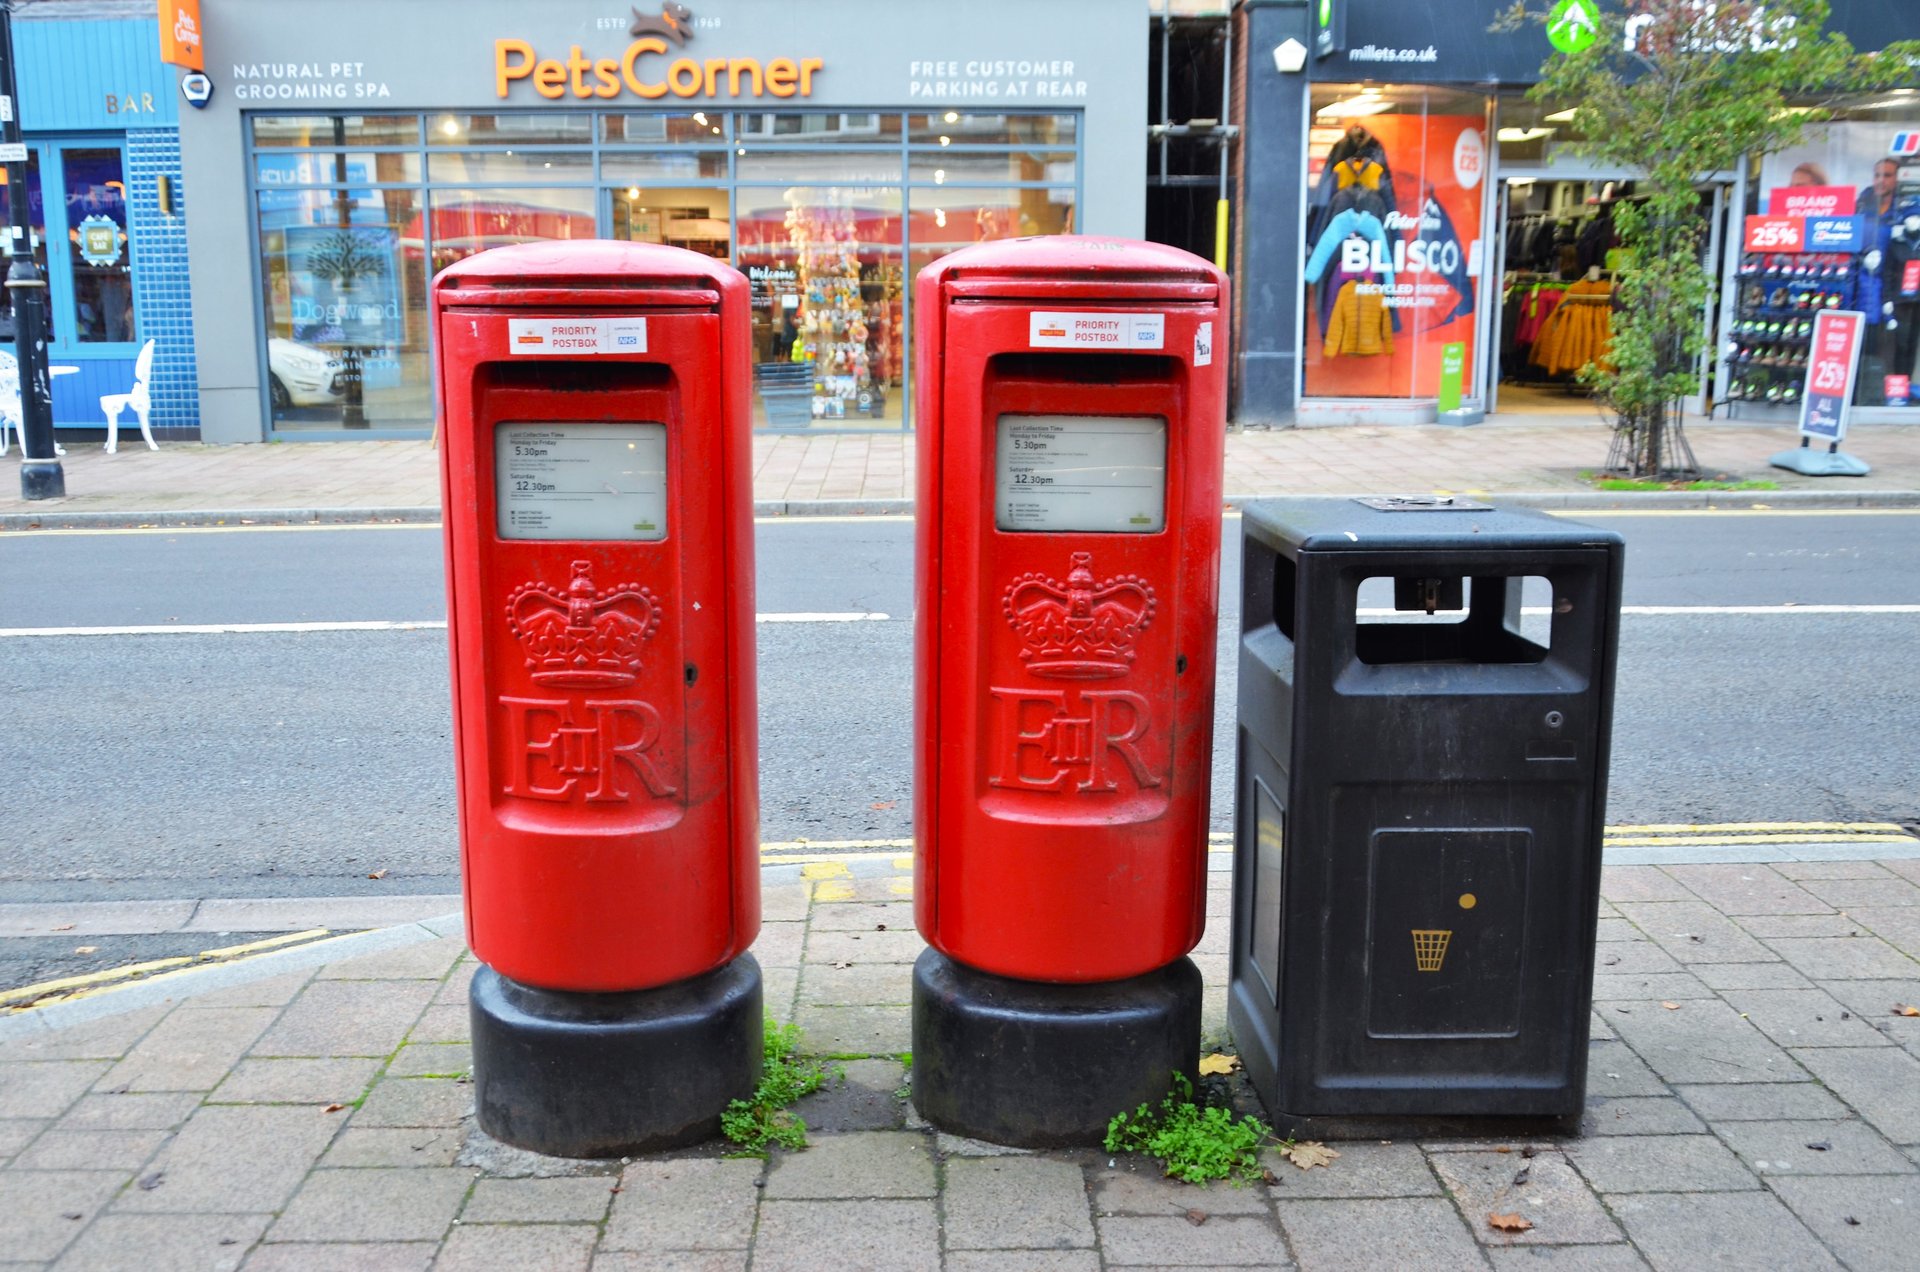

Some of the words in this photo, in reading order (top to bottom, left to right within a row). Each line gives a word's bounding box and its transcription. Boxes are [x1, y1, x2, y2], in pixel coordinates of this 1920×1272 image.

[178, 8, 195, 31] Pets
[174, 22, 200, 46] Corner
[1348, 45, 1438, 62] millets.co.uk
[233, 63, 324, 79] NATURAL
[330, 62, 364, 77] PET
[911, 61, 958, 77] FREE
[965, 60, 1074, 77] CUSTOMER
[234, 83, 347, 99] GROOMING
[354, 82, 390, 98] SPA
[909, 81, 999, 97] PARKING
[1006, 81, 1028, 97] AT
[1036, 81, 1087, 97] REAR
[106, 93, 155, 114] BAR
[1785, 195, 1838, 208] BRAND
[1751, 227, 1799, 246] 25%
[1341, 239, 1458, 274] BLISCO
[750, 265, 796, 281] Welcome
[293, 299, 401, 325] Dogwood
[552, 327, 597, 335] PRIORITY
[1075, 320, 1119, 329] PRIORITY
[553, 339, 597, 347] POSTBOX
[618, 336, 637, 344] NHS
[1075, 333, 1119, 341] POSTBOX
[306, 349, 365, 359] TURAL
[377, 360, 400, 369] SPA
[515, 446, 548, 456] 5.30pm
[1014, 440, 1047, 450] 5.30pm
[516, 481, 555, 491] 12.30pm
[1014, 474, 1054, 485] 12.30pm
